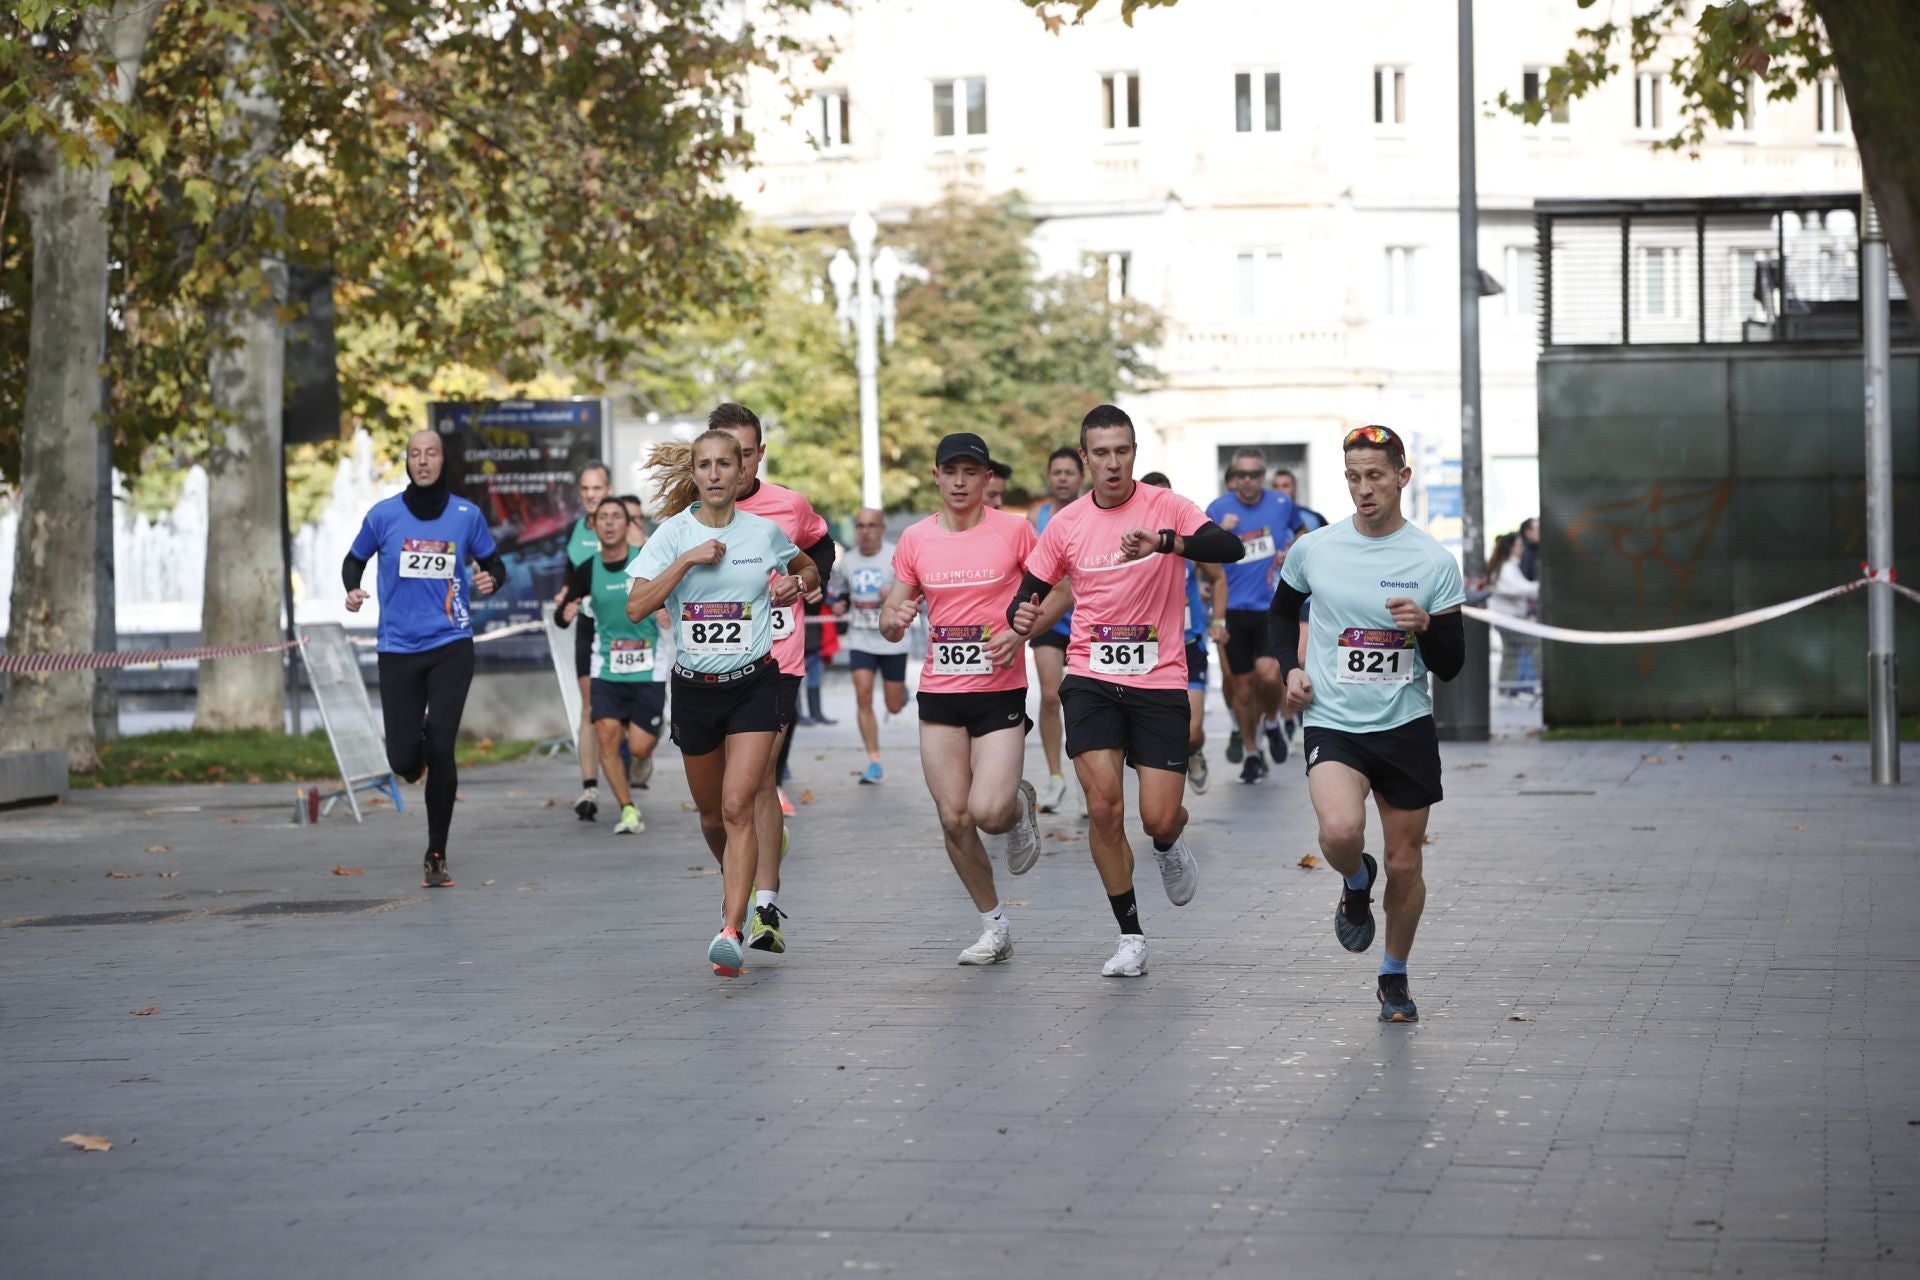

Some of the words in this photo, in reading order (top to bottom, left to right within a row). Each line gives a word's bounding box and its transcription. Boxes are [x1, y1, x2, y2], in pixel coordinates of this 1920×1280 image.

[408, 554, 447, 571] 279
[732, 557, 763, 565] OneHealth
[1380, 580, 1419, 589] OneHealth
[692, 623, 741, 644] 822
[1364, 635, 1392, 643] EMPRESAS
[616, 653, 645, 665] 484
[939, 645, 981, 665] 362
[1100, 644, 1144, 665] 361
[1348, 650, 1399, 673] 821
